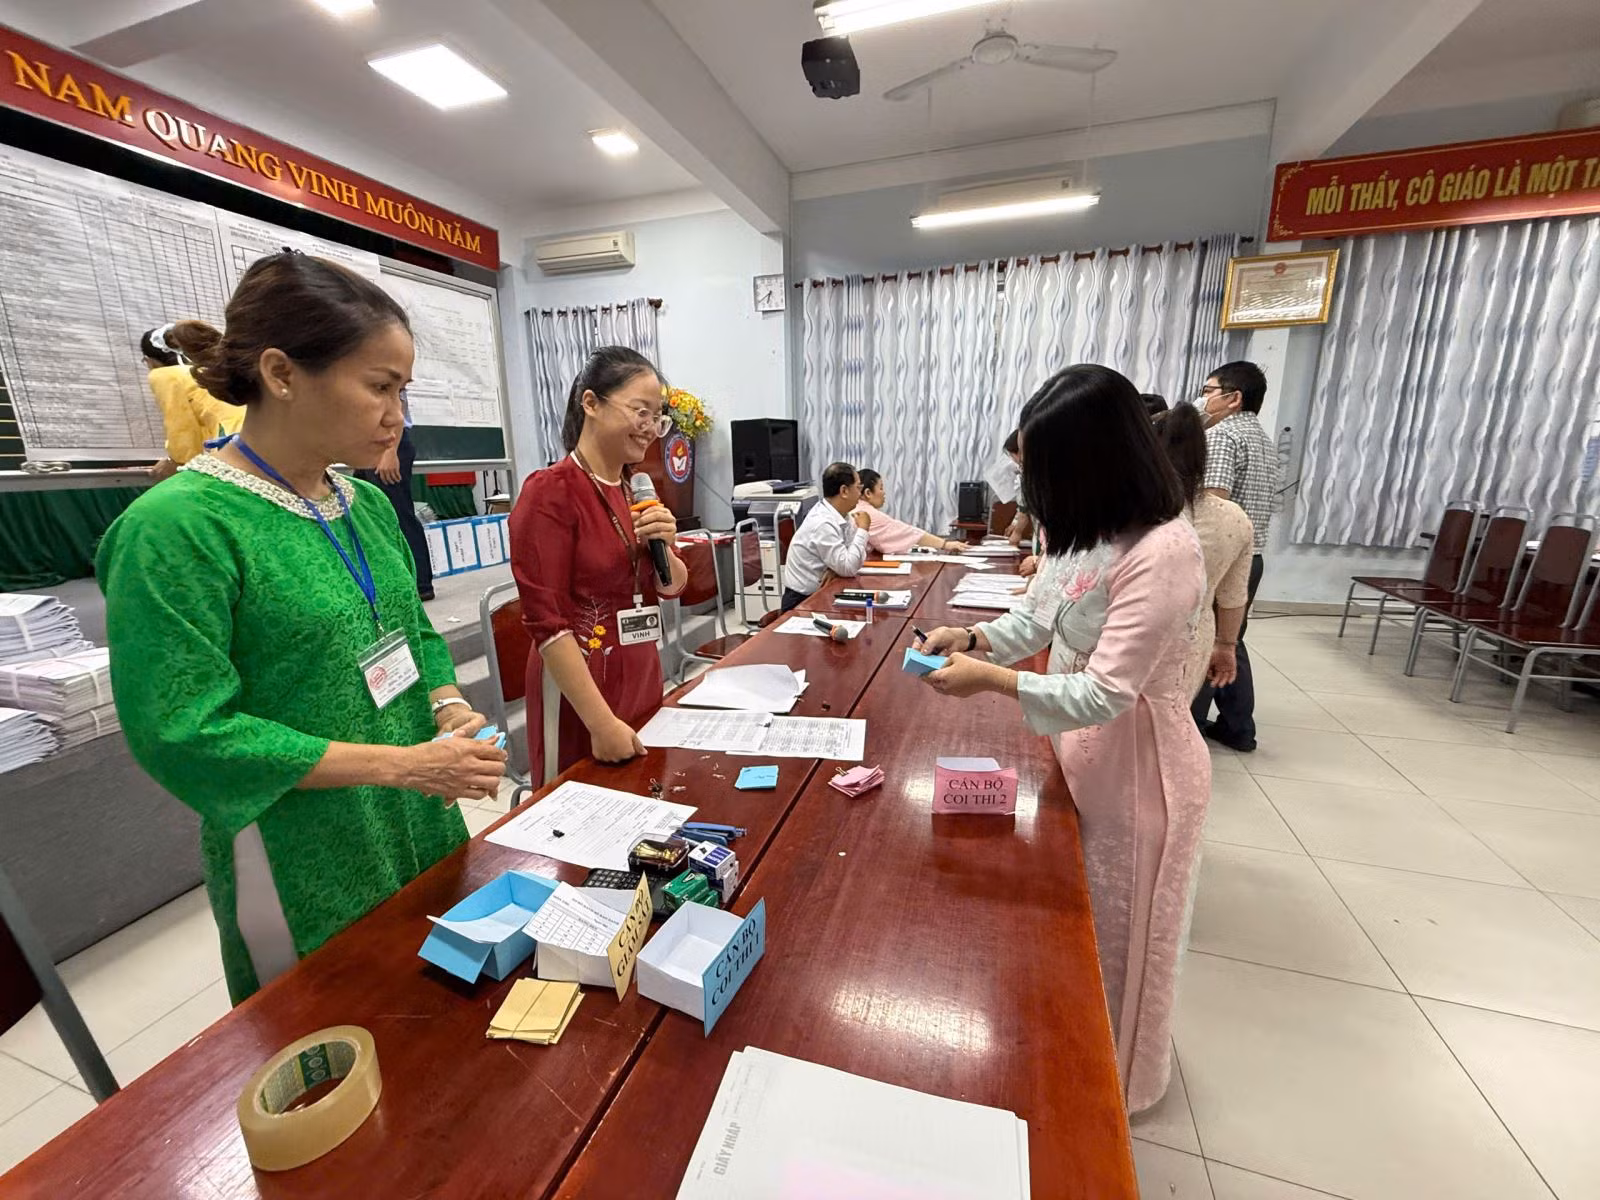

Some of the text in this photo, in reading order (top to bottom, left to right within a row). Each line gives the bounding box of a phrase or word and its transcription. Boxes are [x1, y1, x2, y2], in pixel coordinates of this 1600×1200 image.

[5, 49, 483, 254] NAM QUANG VINH MUÔN NĂM
[1305, 175, 1345, 215] MỖI
[1405, 169, 1434, 206] CÔ
[1438, 164, 1490, 203] GIÁO
[1525, 155, 1579, 198] MỘT
[632, 631, 650, 639] VINH
[943, 793, 1007, 805] COI THI 2
[948, 777, 1003, 791] CÁN BỘ
[711, 970, 732, 1006] COI
[734, 941, 753, 972] THI
[716, 918, 756, 978] CÁN BỘ
